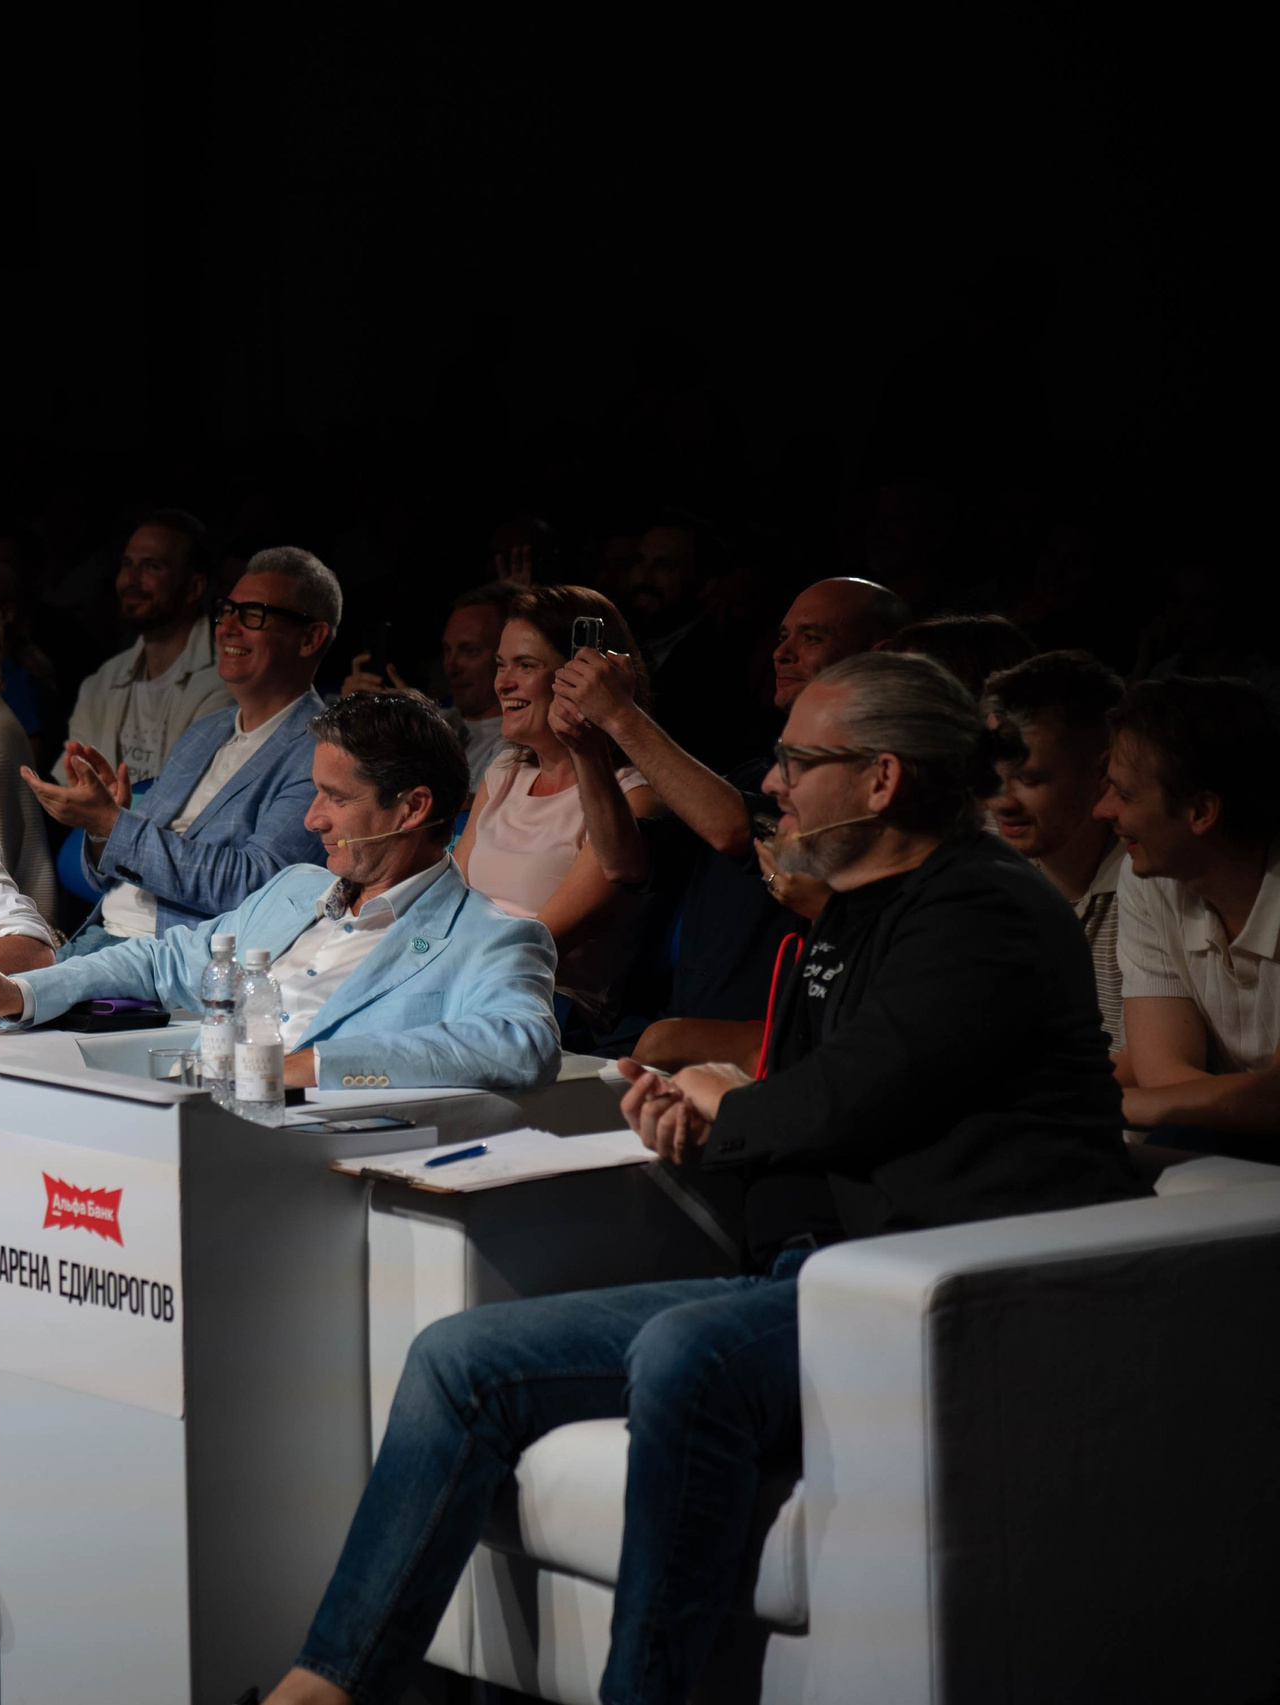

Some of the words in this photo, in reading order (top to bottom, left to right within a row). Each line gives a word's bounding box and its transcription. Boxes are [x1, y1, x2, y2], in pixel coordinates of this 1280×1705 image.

[52, 1193, 86, 1218] Альфа
[86, 1201, 114, 1222] Банк
[58, 1259, 175, 1323] ЕДИНОРОГОВ
